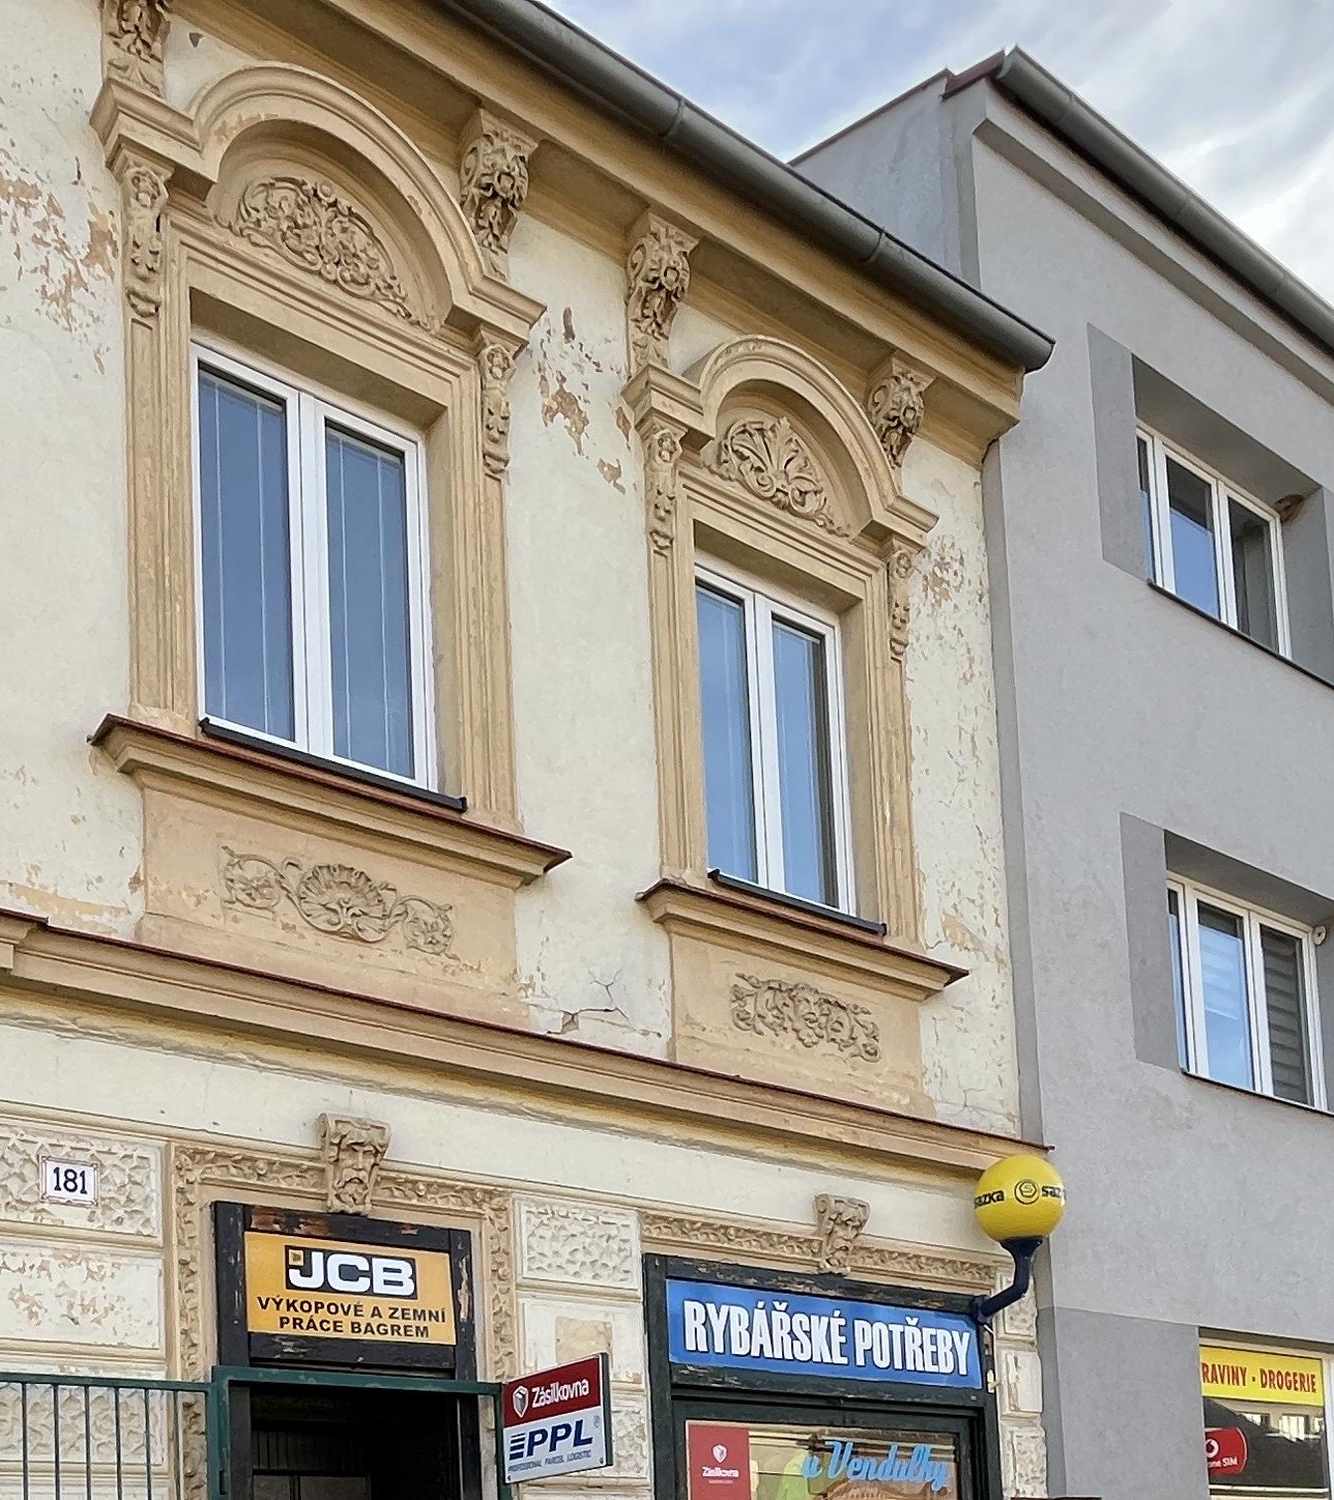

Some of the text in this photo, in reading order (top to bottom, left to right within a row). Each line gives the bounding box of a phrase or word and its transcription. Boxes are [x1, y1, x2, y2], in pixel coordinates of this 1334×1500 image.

[53, 1166, 88, 1195] 181
[287, 1250, 416, 1297] JCB
[257, 1294, 447, 1323] VÝKOPOVÉ A ZEMNÍ
[279, 1315, 430, 1339] PRÁCE BAGREM
[683, 1299, 971, 1376] RYBÁŘSKÉ POTŘEBY
[531, 1379, 589, 1408] Zásilkovna
[1259, 1367, 1317, 1393] DROGERIE
[526, 1419, 594, 1458] PPL
